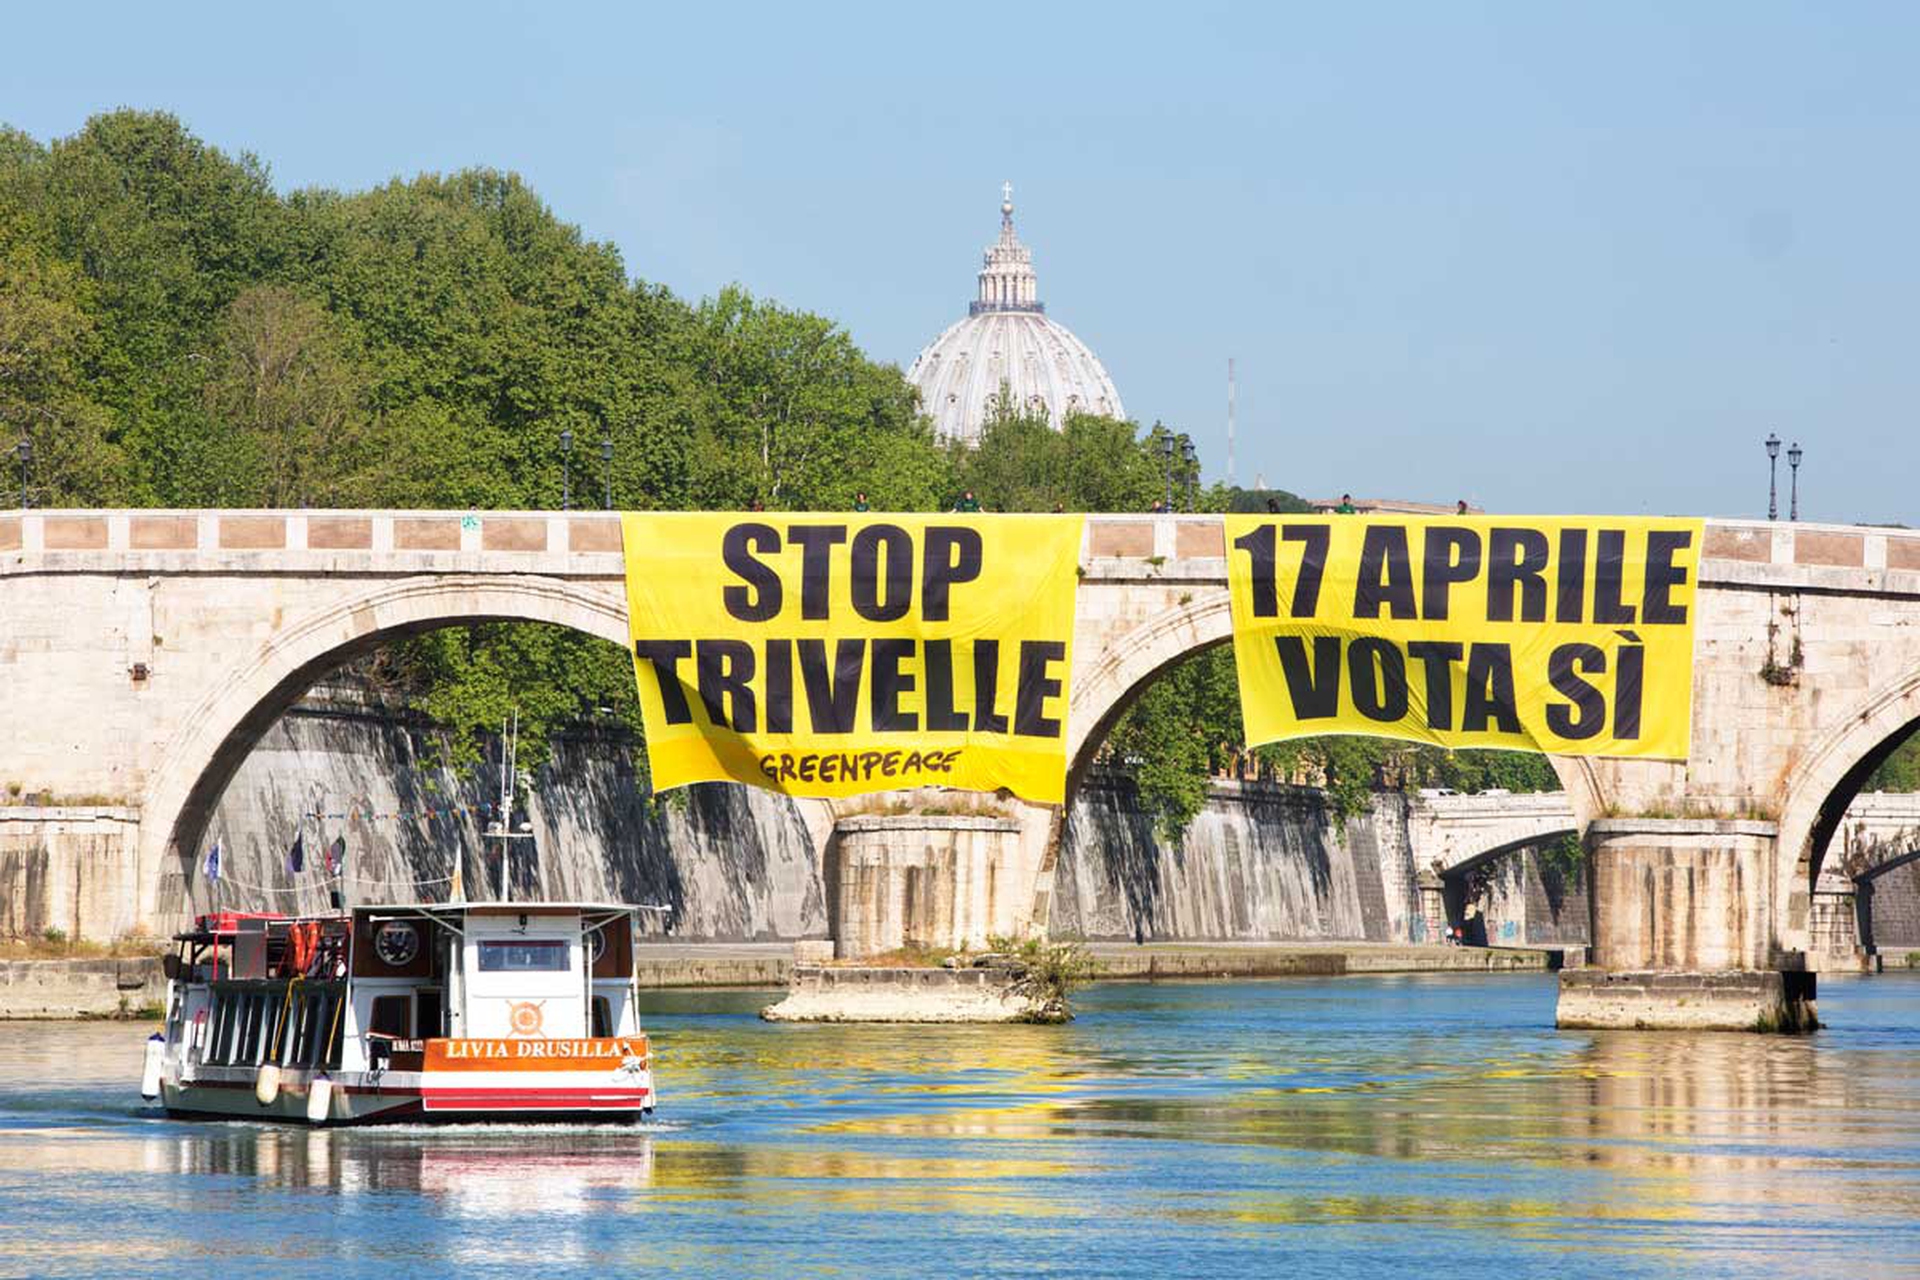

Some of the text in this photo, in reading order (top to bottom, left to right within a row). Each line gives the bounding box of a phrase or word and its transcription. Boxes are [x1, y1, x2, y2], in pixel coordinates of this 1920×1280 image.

[723, 522, 983, 622] STOP
[1234, 524, 1693, 625] 17 APRILE
[635, 638, 1066, 738] TRIVELLE
[1274, 630, 1646, 740] VOTA SÌ
[759, 751, 963, 783] GREENPEACE
[446, 1041, 623, 1058] LIVIA DRUSILLA
